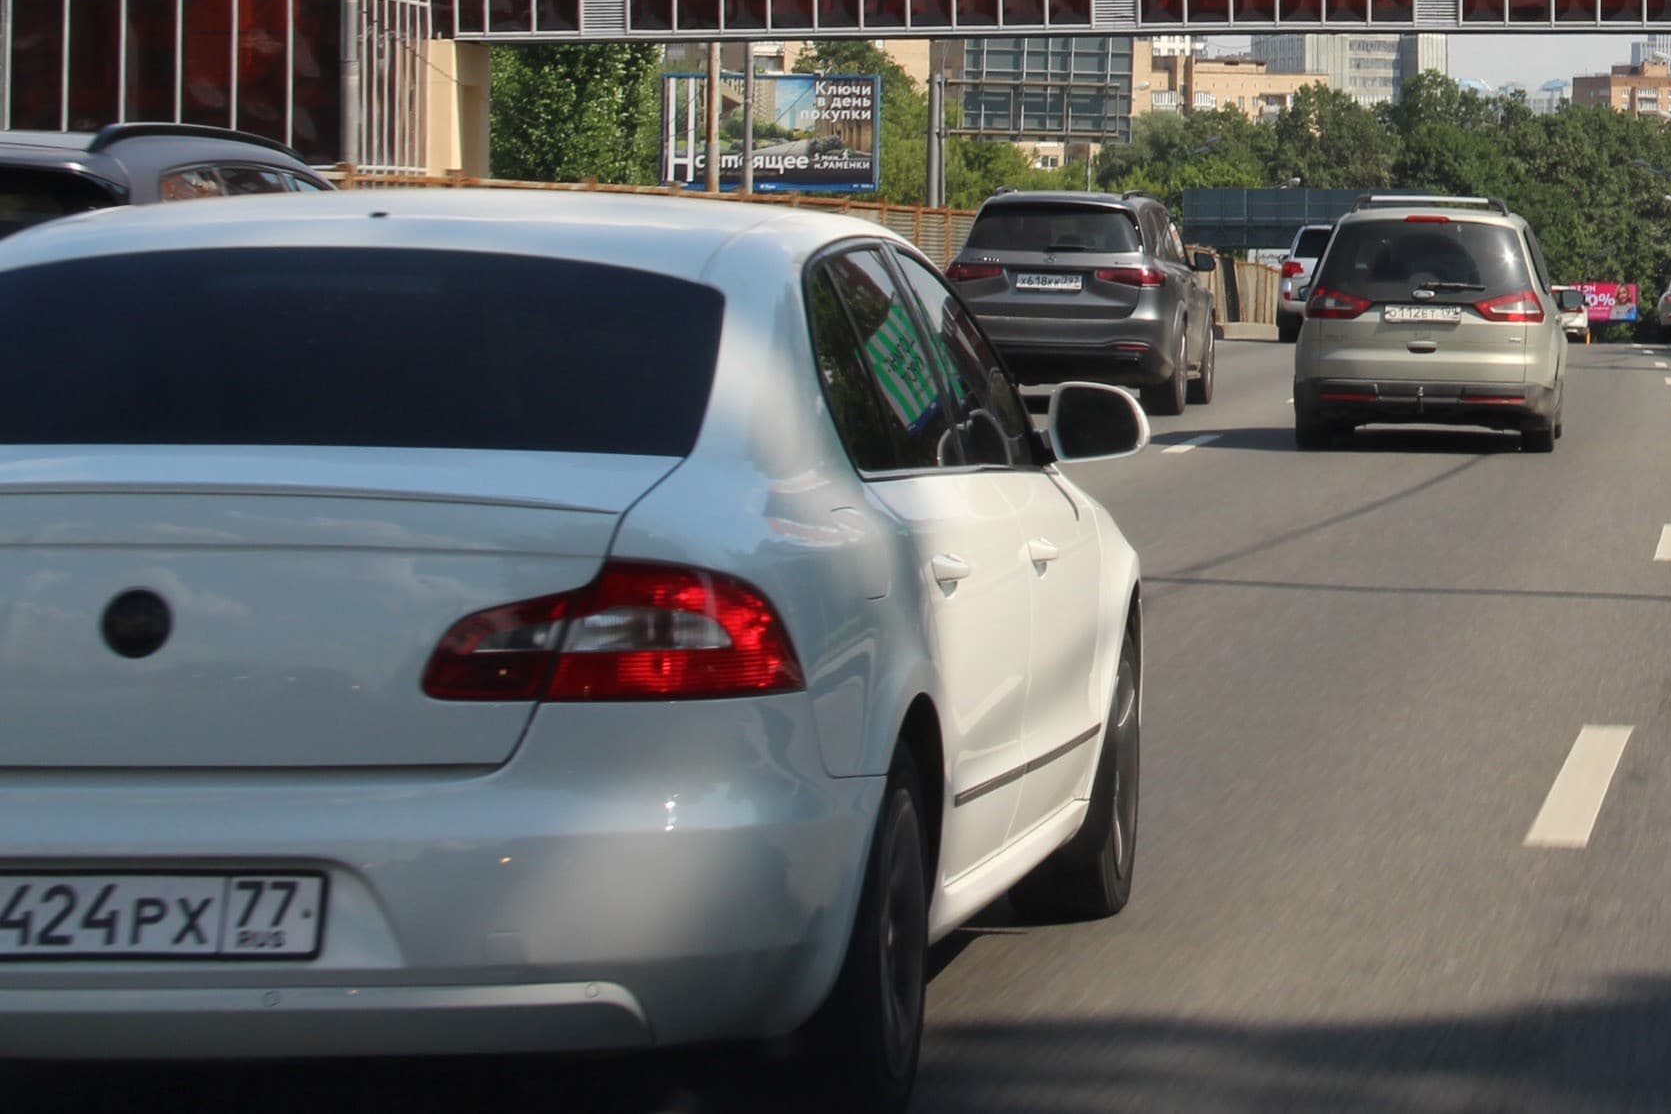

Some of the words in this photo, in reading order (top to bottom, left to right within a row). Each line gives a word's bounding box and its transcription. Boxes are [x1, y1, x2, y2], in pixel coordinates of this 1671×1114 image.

[815, 80, 872, 96] Ключи
[817, 96, 826, 108] в
[831, 96, 872, 109] день
[800, 109, 872, 123] покупки
[234, 880, 299, 928] 77
[236, 930, 287, 948] RUS
